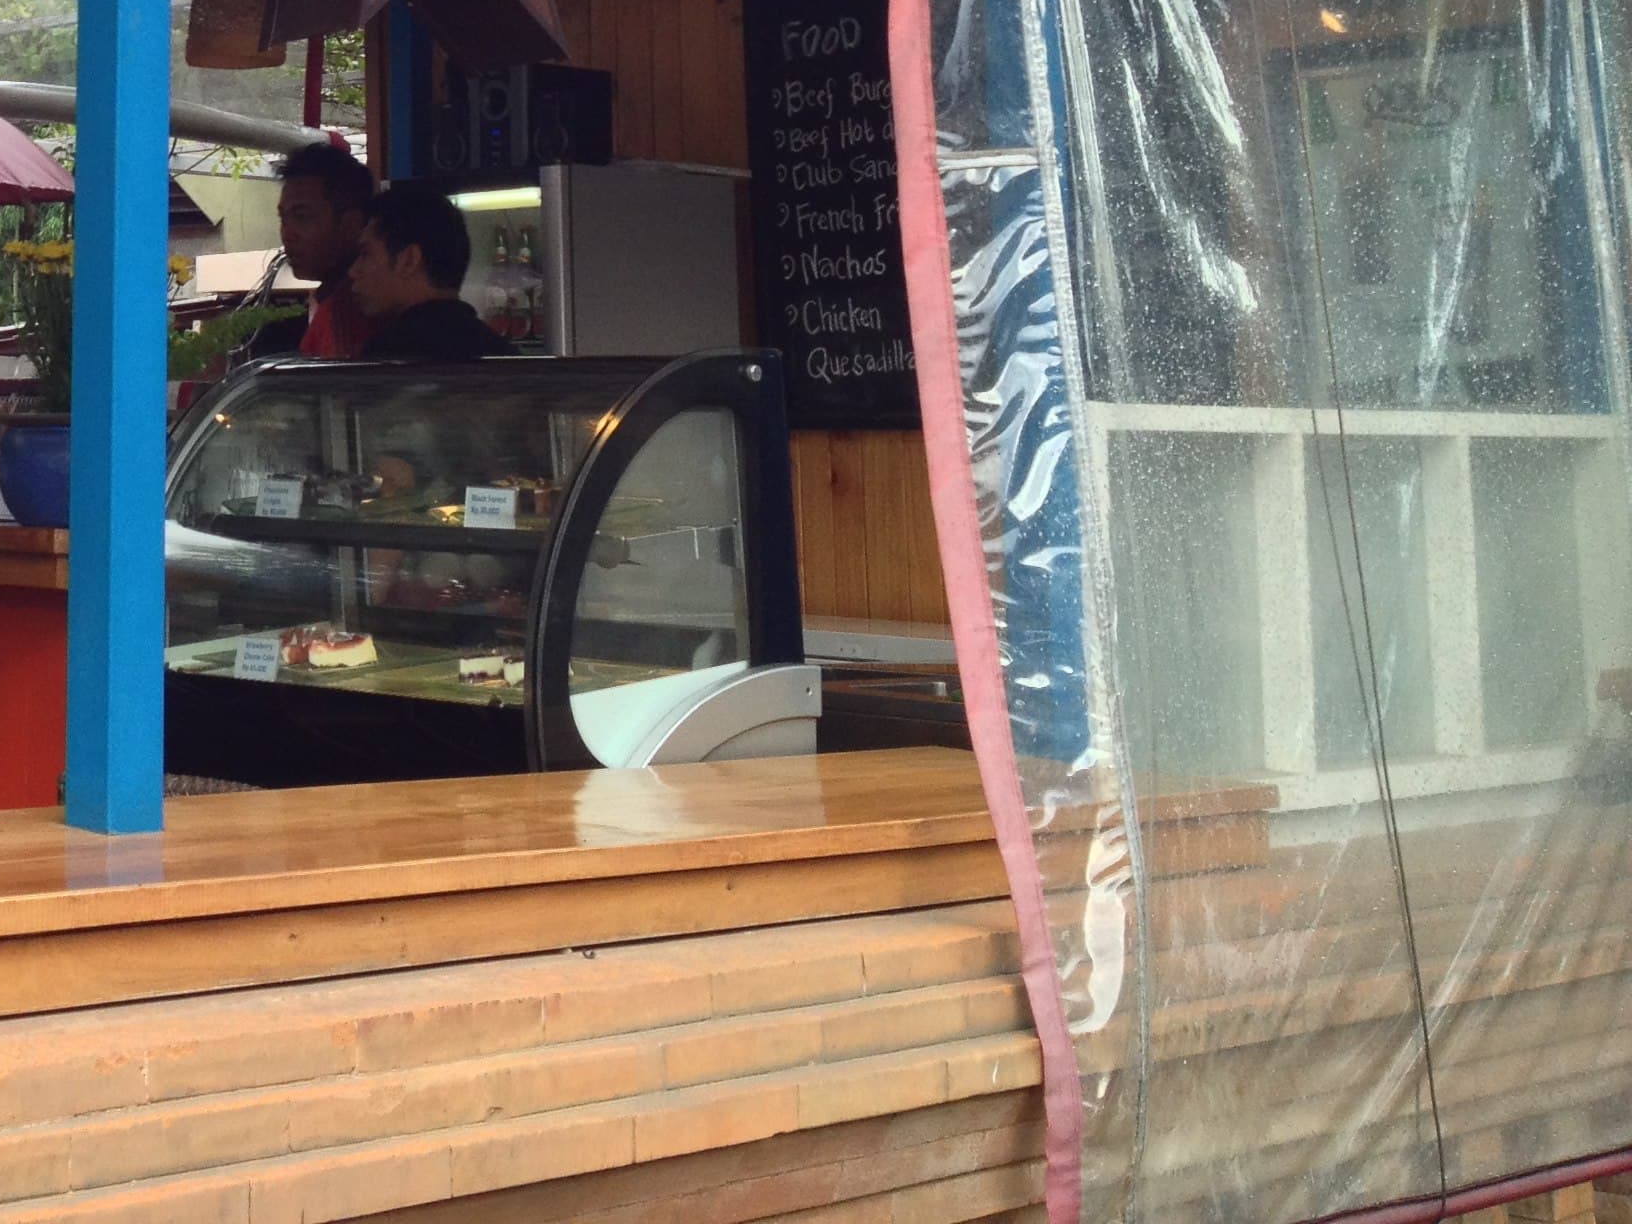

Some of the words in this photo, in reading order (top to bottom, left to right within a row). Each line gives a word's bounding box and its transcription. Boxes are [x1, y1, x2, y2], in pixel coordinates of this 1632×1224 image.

[785, 77, 833, 118] Beef
[789, 125, 829, 159] Beef
[840, 117, 875, 148] Hot
[792, 158, 843, 191] Club
[796, 194, 864, 239] French
[799, 243, 887, 286] Nachos
[803, 297, 882, 335] Chicken
